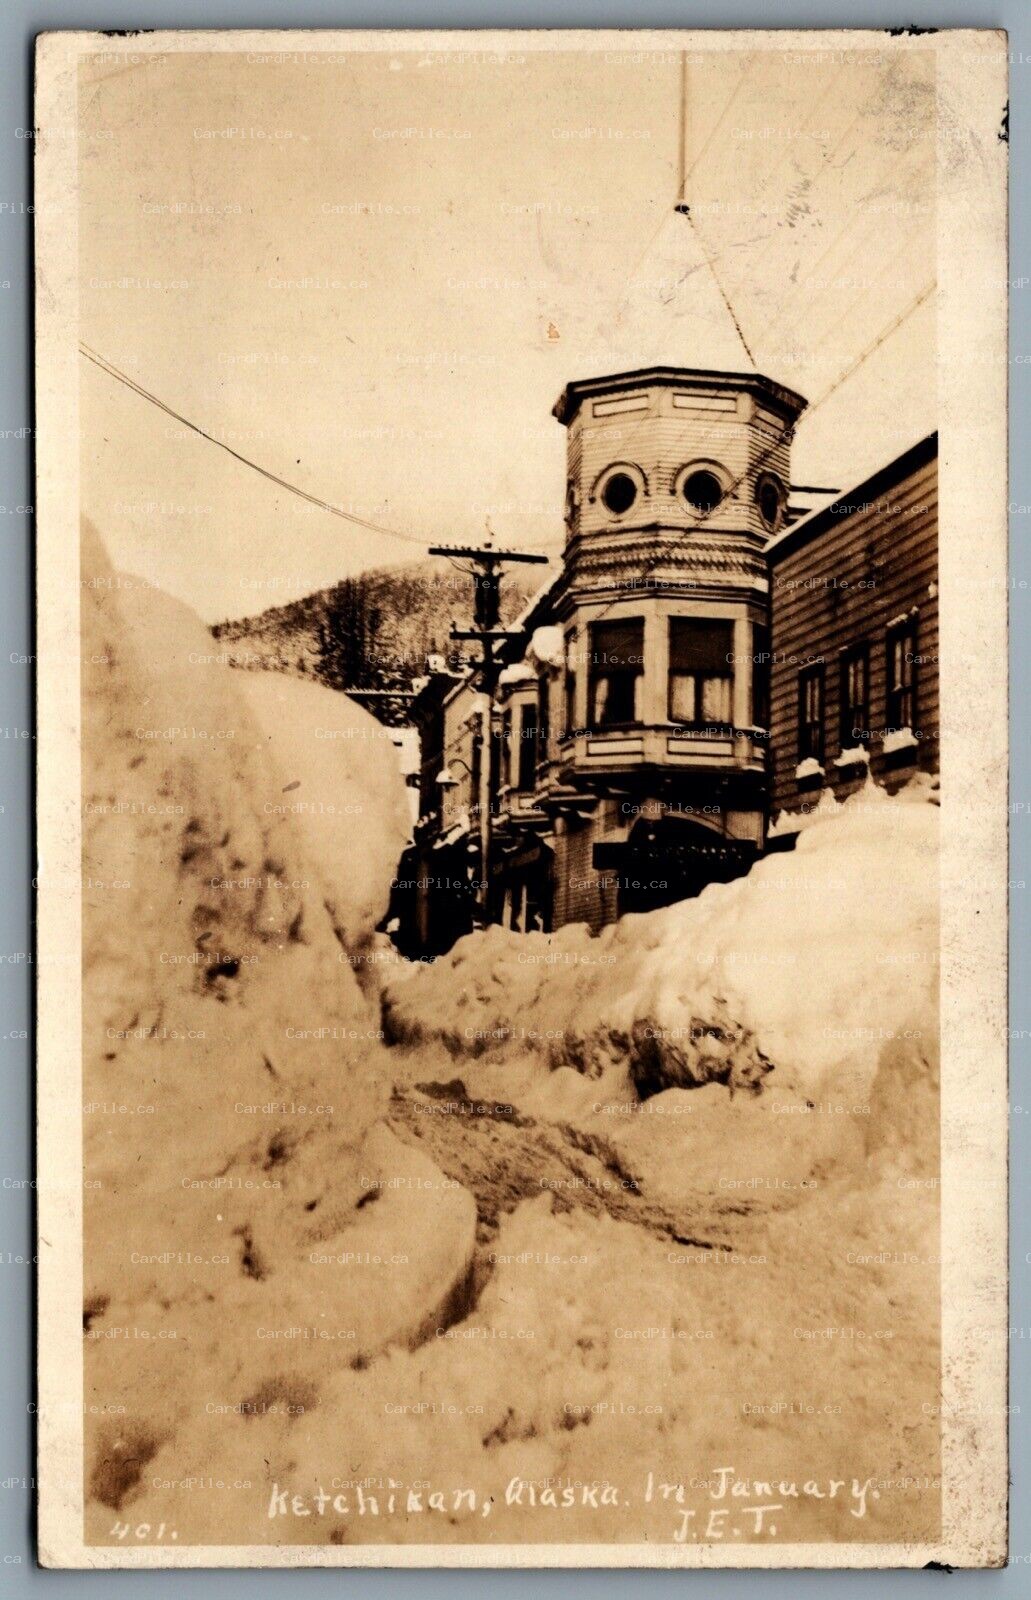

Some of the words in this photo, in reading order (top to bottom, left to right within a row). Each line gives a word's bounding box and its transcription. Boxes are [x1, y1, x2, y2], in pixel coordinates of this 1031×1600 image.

[645, 1472, 685, 1504] In
[710, 1467, 882, 1518] January.
[109, 1521, 179, 1540] 401.
